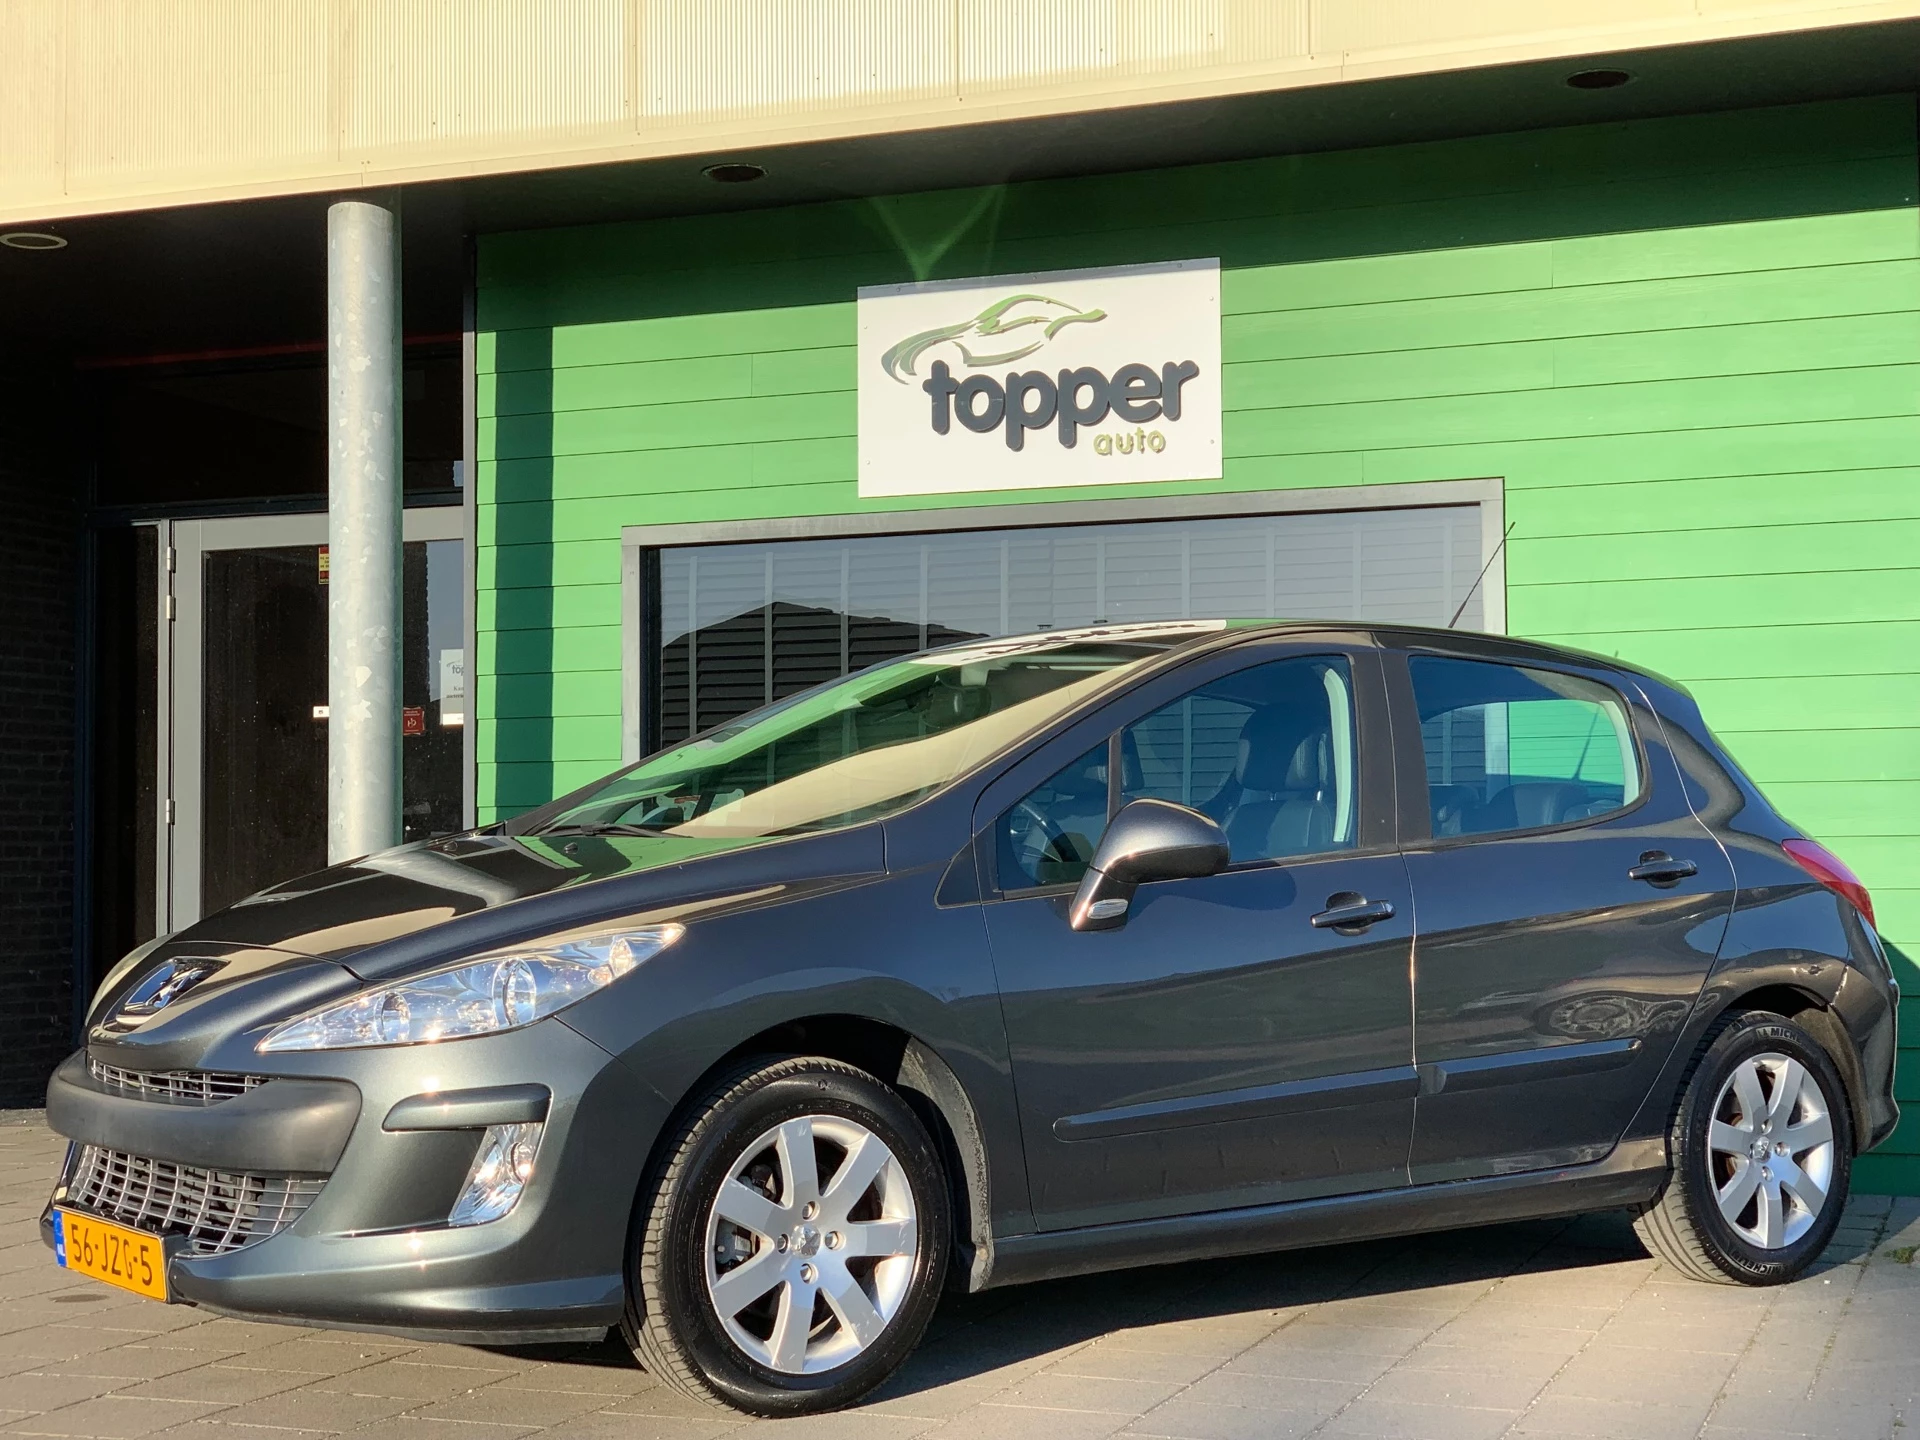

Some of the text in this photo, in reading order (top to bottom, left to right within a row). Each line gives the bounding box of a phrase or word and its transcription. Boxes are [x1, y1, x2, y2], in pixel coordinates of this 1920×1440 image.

[923, 359, 1199, 452] topper
[1093, 427, 1165, 456] auto
[70, 1223, 153, 1287] 56-JZG-5
